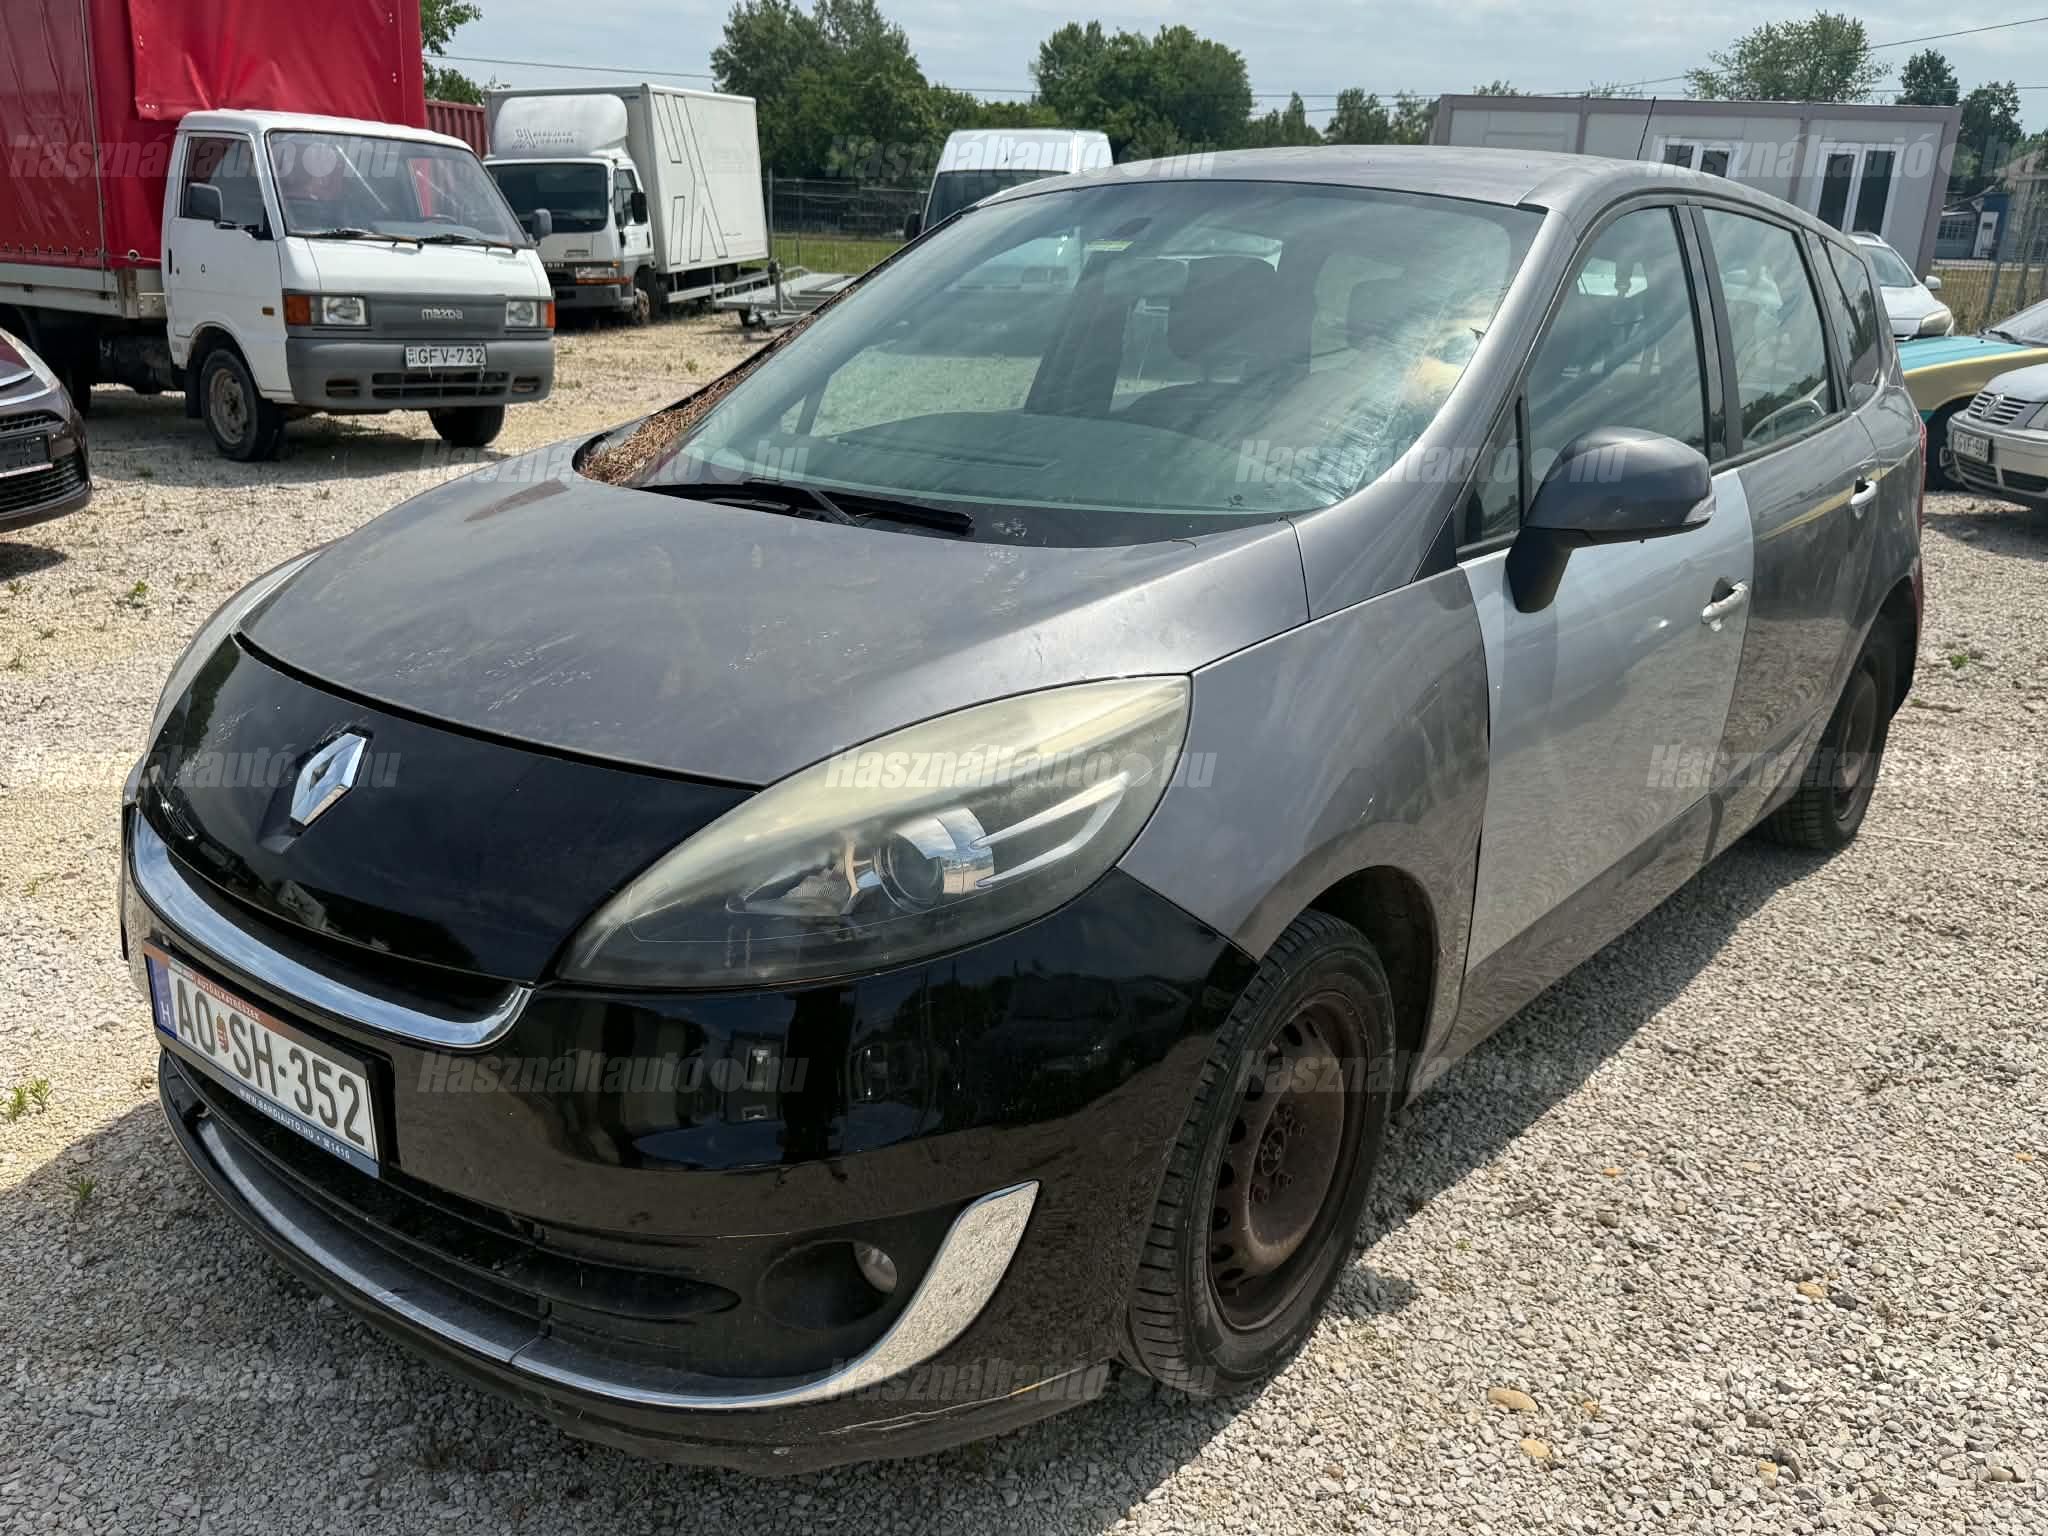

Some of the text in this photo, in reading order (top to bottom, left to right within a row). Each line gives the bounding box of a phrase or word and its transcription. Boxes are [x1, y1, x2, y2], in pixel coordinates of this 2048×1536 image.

[417, 346, 485, 364] GFV-732
[176, 977, 217, 1057] AO
[228, 1012, 365, 1146] SH-352
